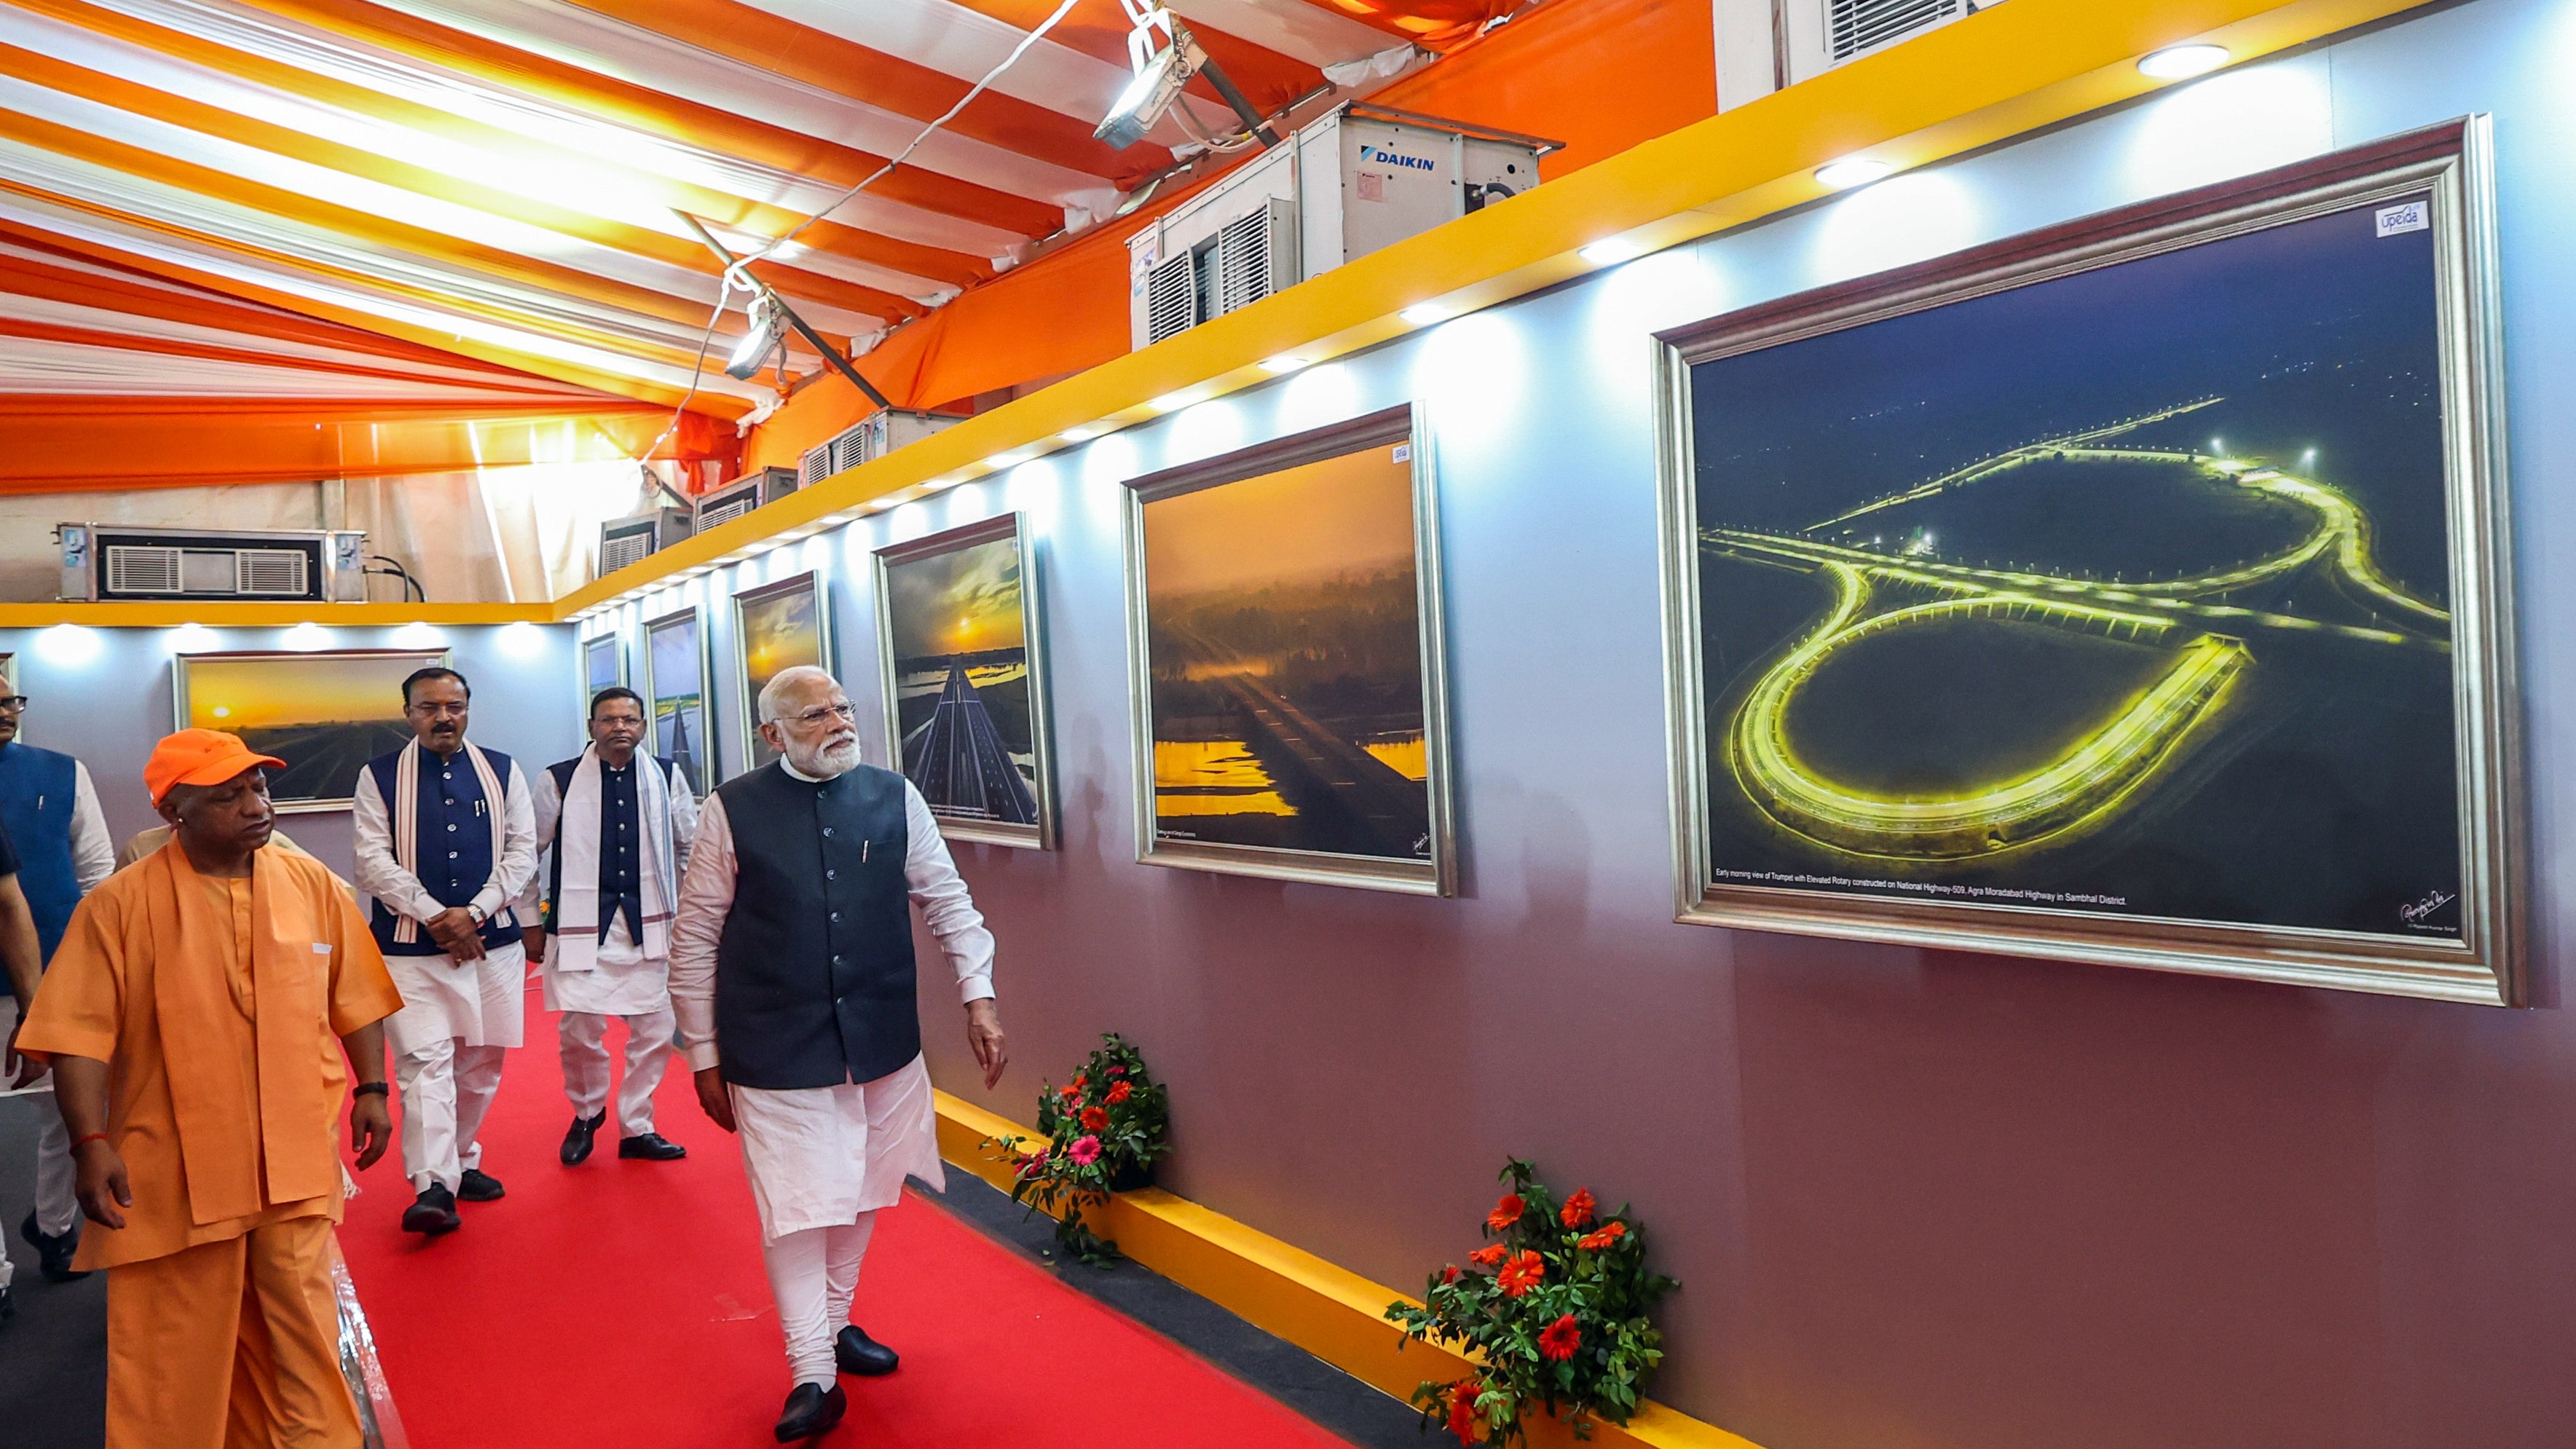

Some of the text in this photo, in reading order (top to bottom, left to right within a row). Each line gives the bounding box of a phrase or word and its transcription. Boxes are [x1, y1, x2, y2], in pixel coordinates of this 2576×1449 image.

[1376, 151, 1434, 171] DAIKIN
[1716, 868, 1729, 878] Early
[1730, 871, 1751, 880] morning
[1771, 872, 1794, 882] Trumpet
[1806, 874, 1831, 884] Elevated
[1832, 877, 1851, 887] Rotary
[1852, 879, 1886, 888] constructed
[1896, 881, 1922, 891] National
[1967, 886, 1984, 896] Agra
[1985, 888, 2024, 898] Moradabad
[2025, 890, 2055, 902] Highway
[2057, 893, 2064, 901] in
[2065, 893, 2098, 903] Sambhal
